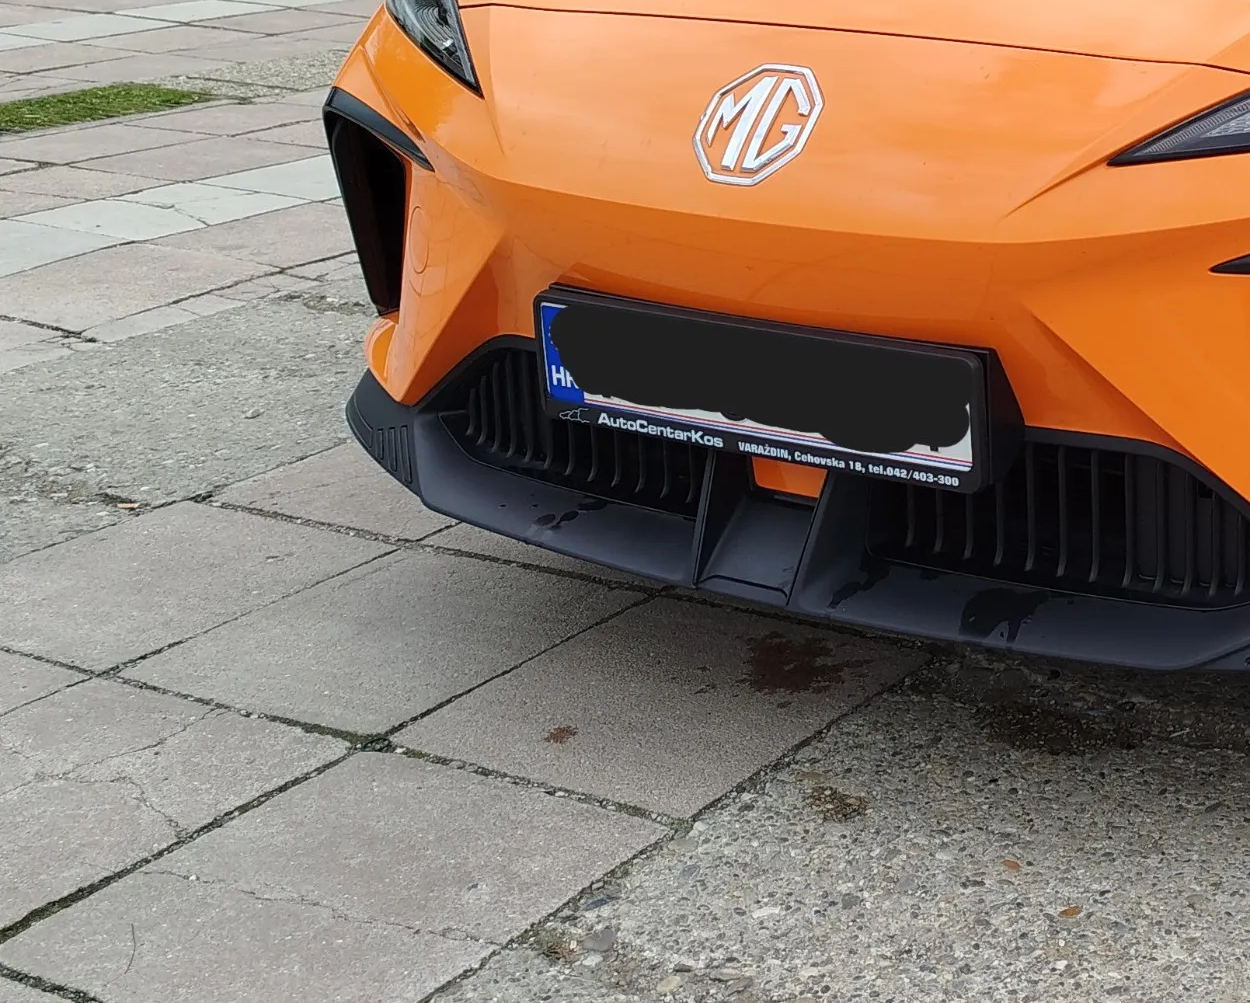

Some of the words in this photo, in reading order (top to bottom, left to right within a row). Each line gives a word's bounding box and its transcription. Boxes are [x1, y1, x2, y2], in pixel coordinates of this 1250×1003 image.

[705, 75, 812, 173] MG
[597, 412, 724, 448] AutoCentarKos
[737, 441, 792, 461] VARAŽDIN,
[794, 451, 845, 469] Cehovska
[848, 460, 866, 474] 18,
[868, 464, 960, 487] tel.042/403-300
